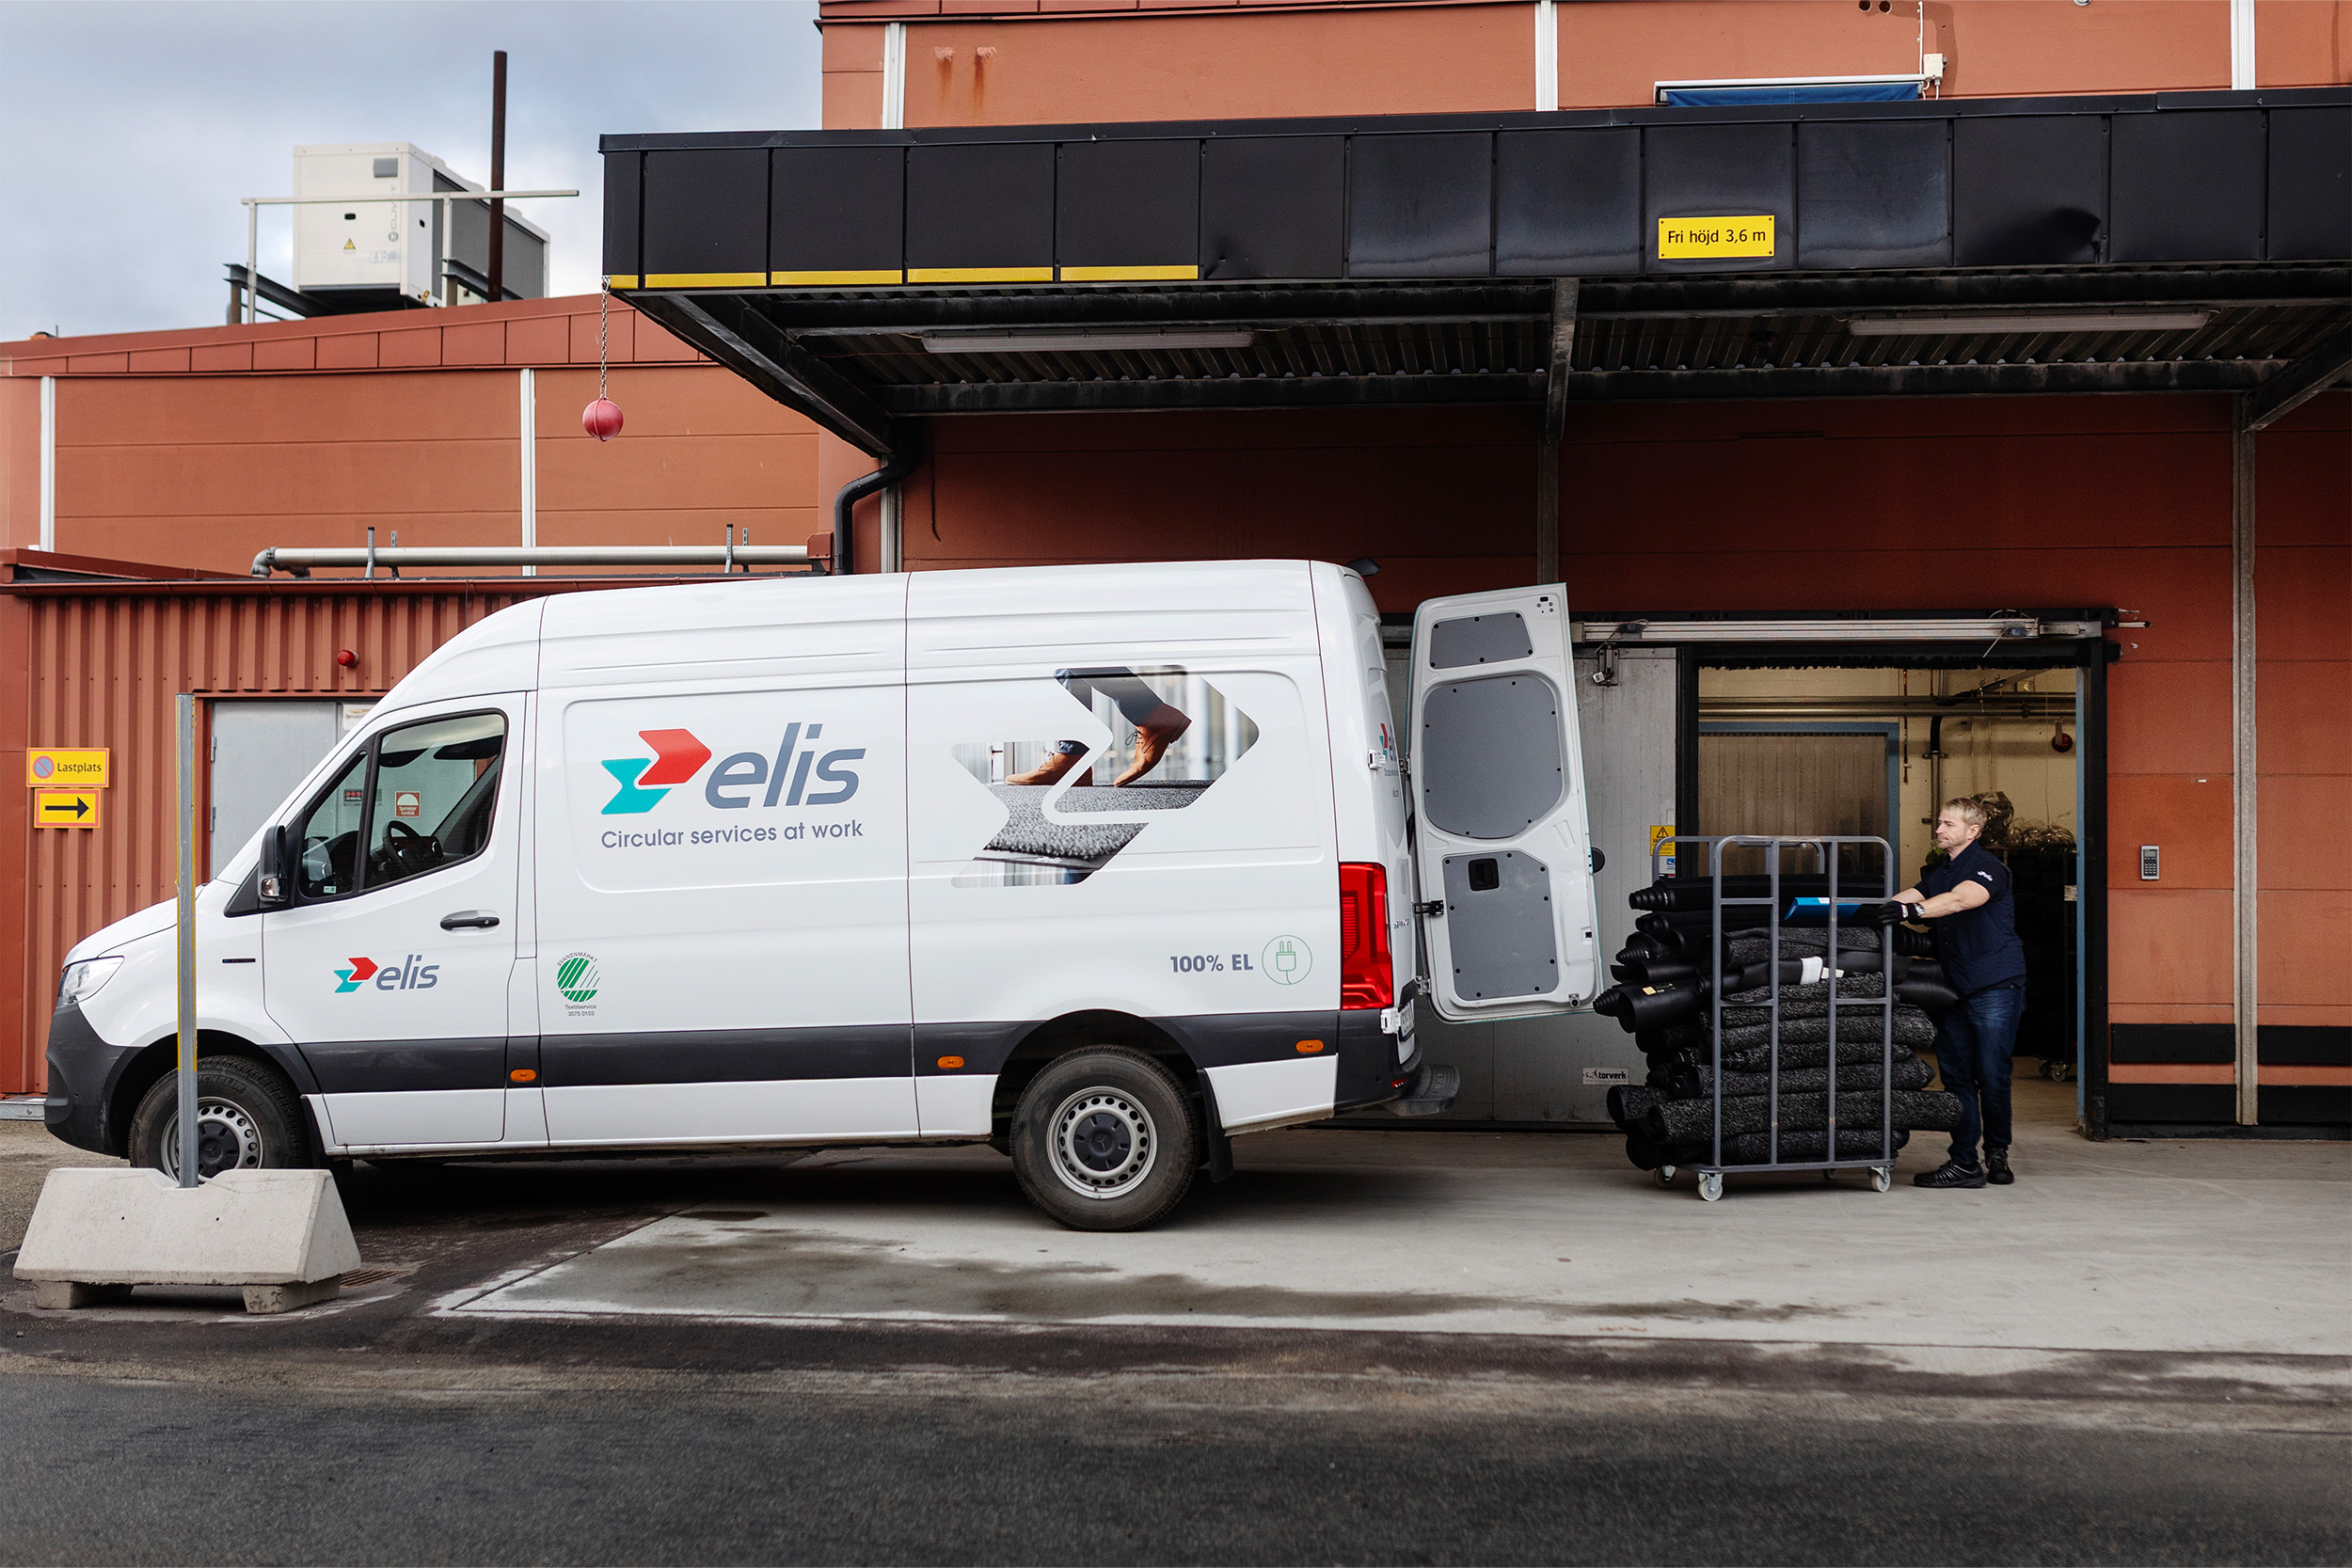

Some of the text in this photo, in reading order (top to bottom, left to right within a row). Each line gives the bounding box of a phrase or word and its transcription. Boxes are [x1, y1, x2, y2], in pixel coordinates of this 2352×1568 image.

[1668, 229, 1766, 245] Fri höjd 3,6 m
[57, 763, 102, 774] Lastplats
[705, 722, 866, 809] elis
[601, 819, 864, 848] Circular services at work
[375, 954, 440, 990] elis
[1169, 954, 1254, 973] 100% EL
[197, 1073, 246, 1092] ICHELIN
